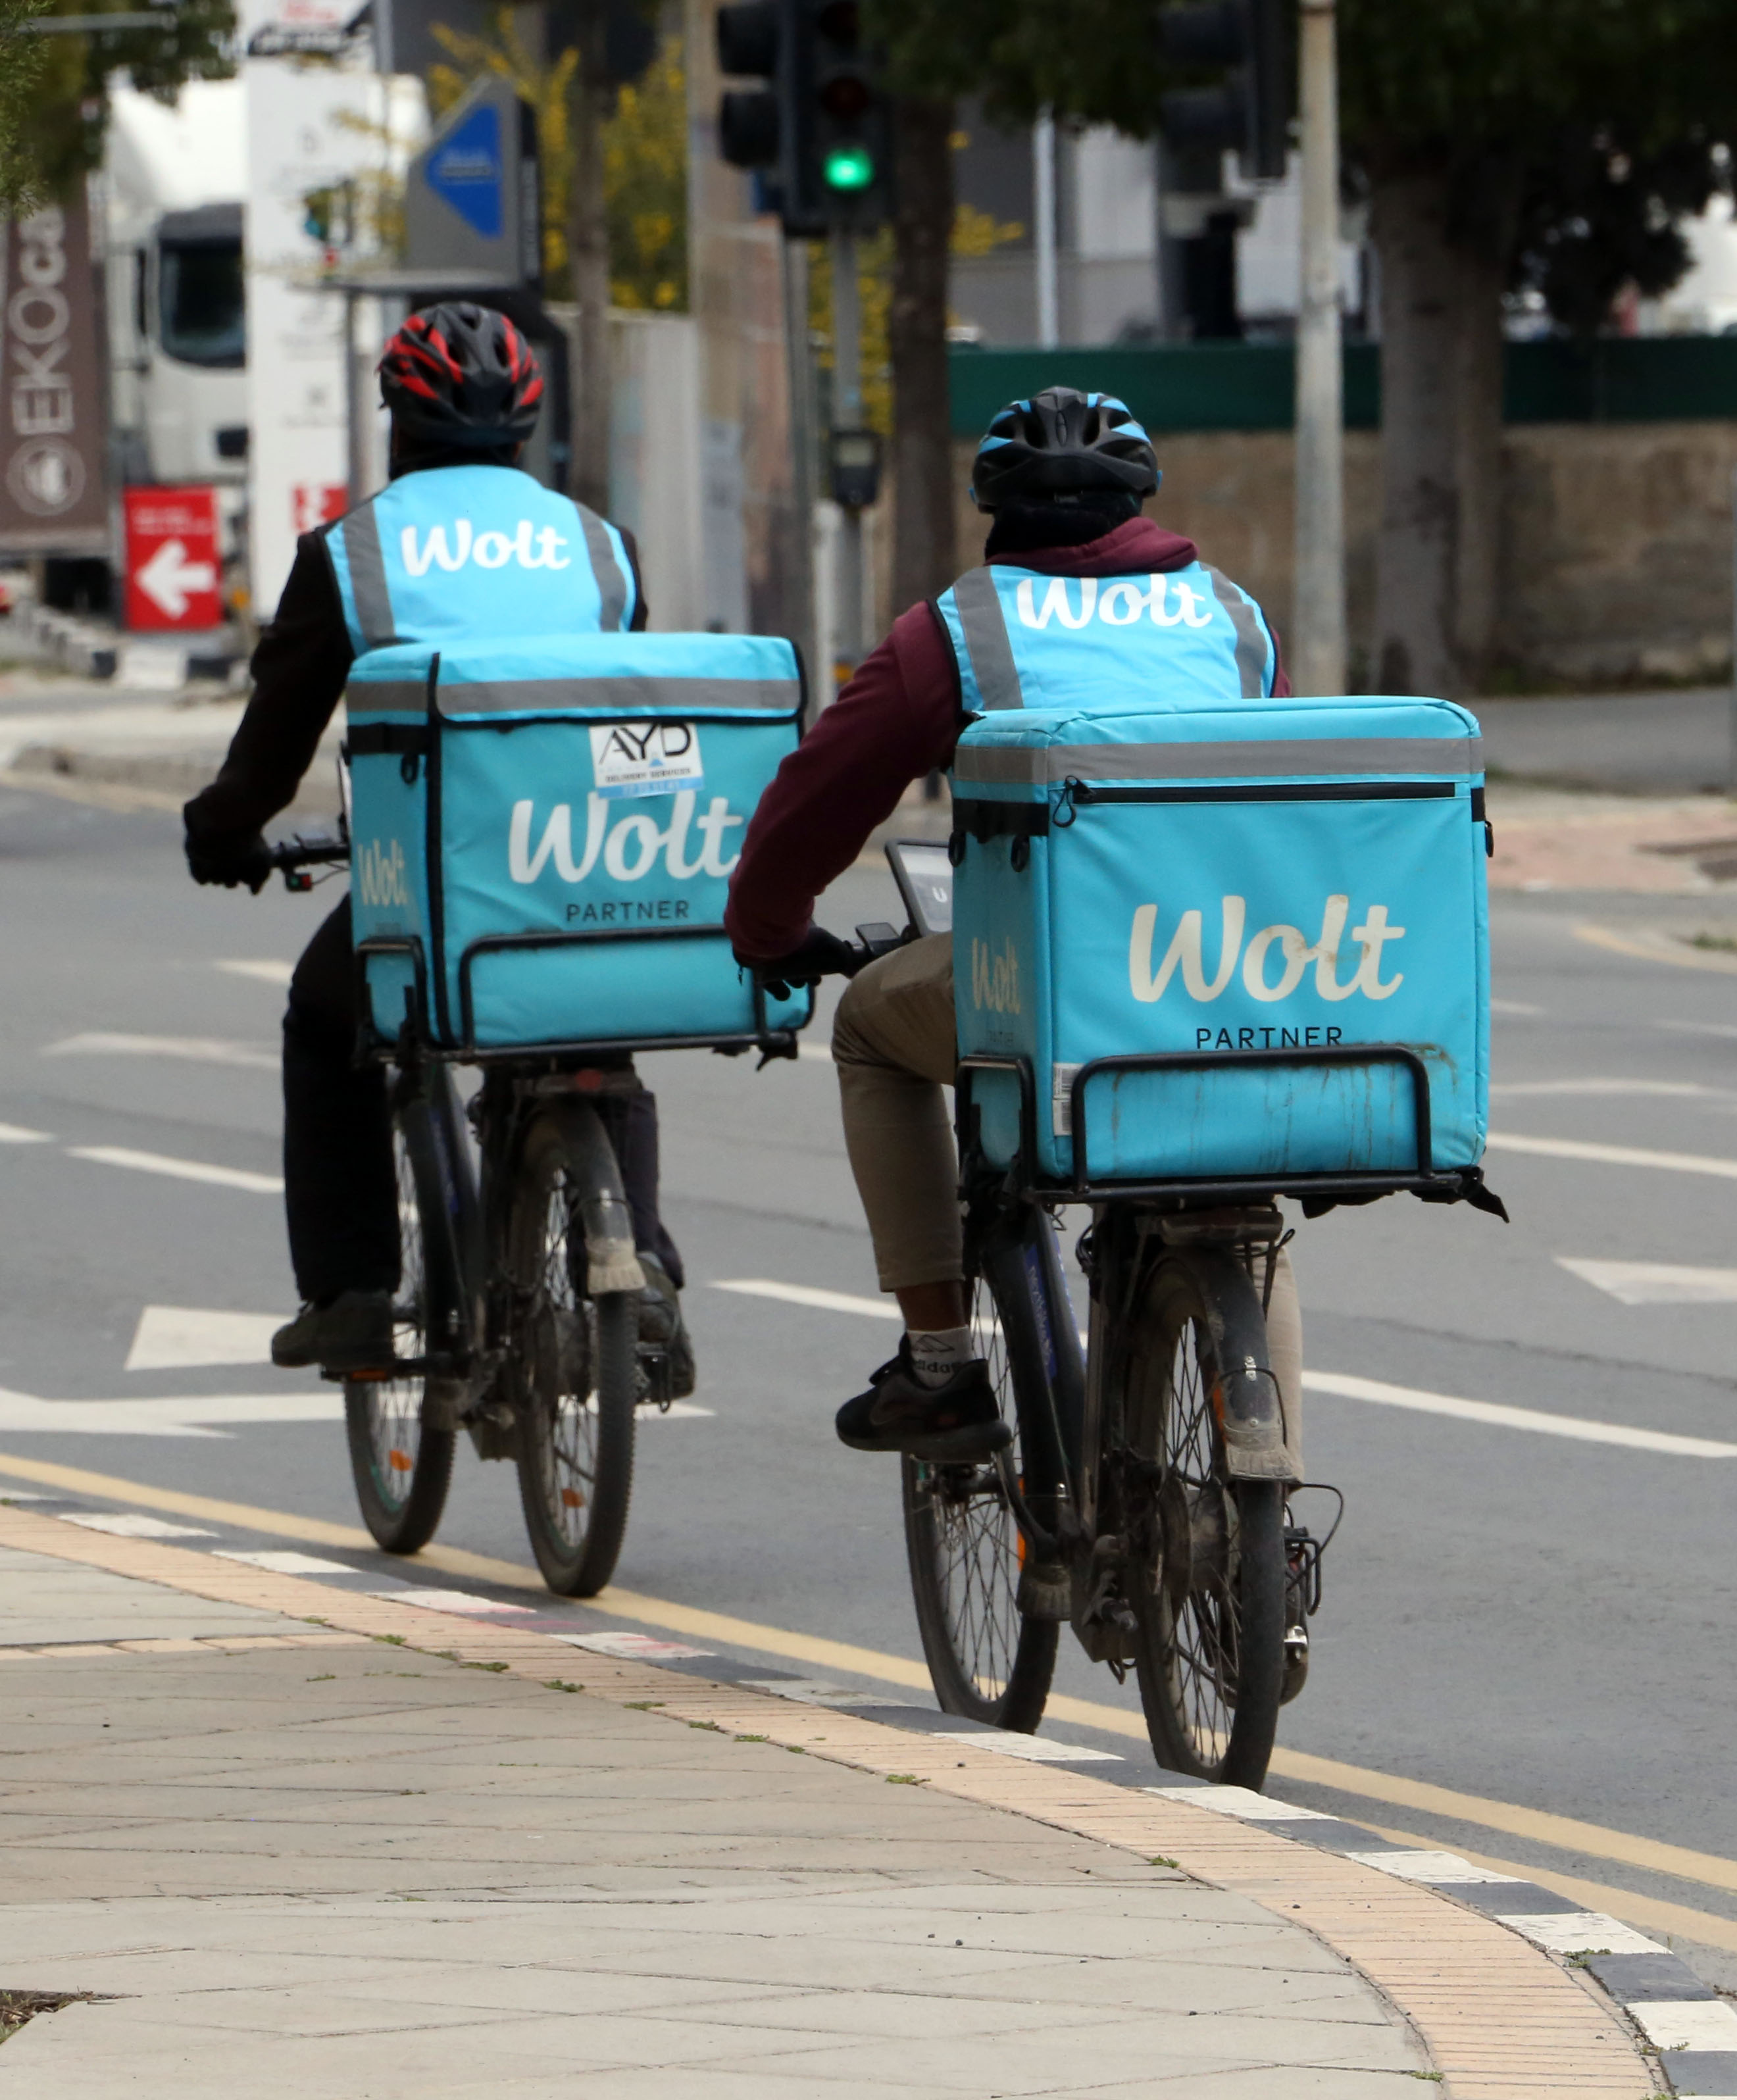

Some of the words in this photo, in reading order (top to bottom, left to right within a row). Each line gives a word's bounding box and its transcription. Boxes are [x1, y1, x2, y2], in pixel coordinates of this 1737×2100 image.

[401, 519, 571, 576] Wolt
[1017, 573, 1213, 629] Wolt
[599, 724, 691, 764] AYD
[509, 791, 744, 884] Wolt
[357, 838, 408, 907] Wolt
[566, 899, 690, 922] PARTNER
[971, 936, 1021, 1015] Wolt
[1129, 894, 1406, 1003] Wolt
[1197, 1026, 1342, 1049] PARTNER
